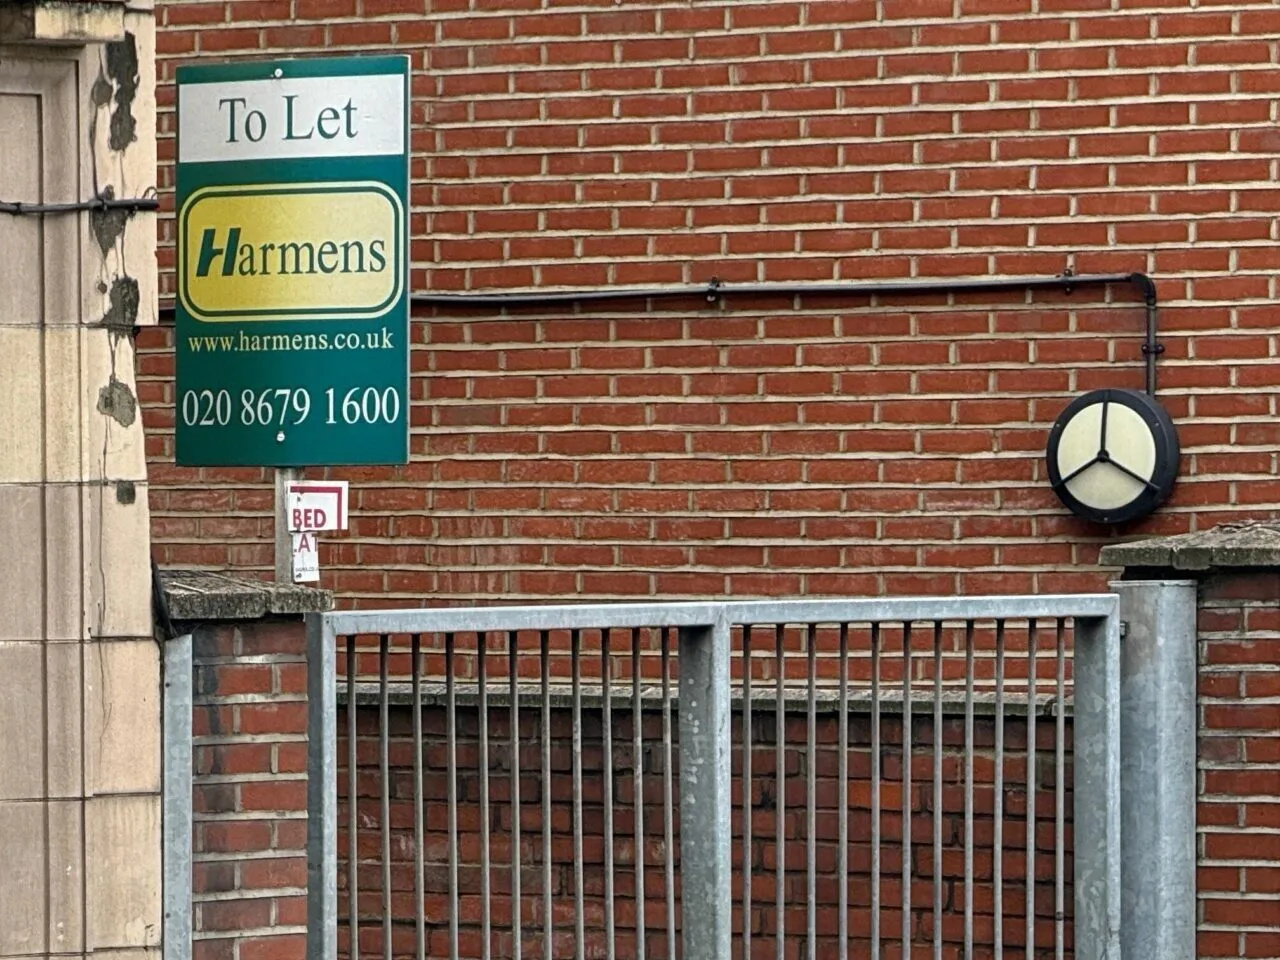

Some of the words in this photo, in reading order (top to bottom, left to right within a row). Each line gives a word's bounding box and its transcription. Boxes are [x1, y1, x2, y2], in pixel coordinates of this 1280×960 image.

[219, 98, 268, 143] To
[282, 94, 359, 141] Let
[195, 227, 387, 278] Harmens
[187, 326, 395, 353] www.harmens.co.uk
[182, 389, 232, 426] 020
[240, 387, 311, 426] 8679
[324, 386, 400, 425] 1600
[292, 508, 327, 529] BED
